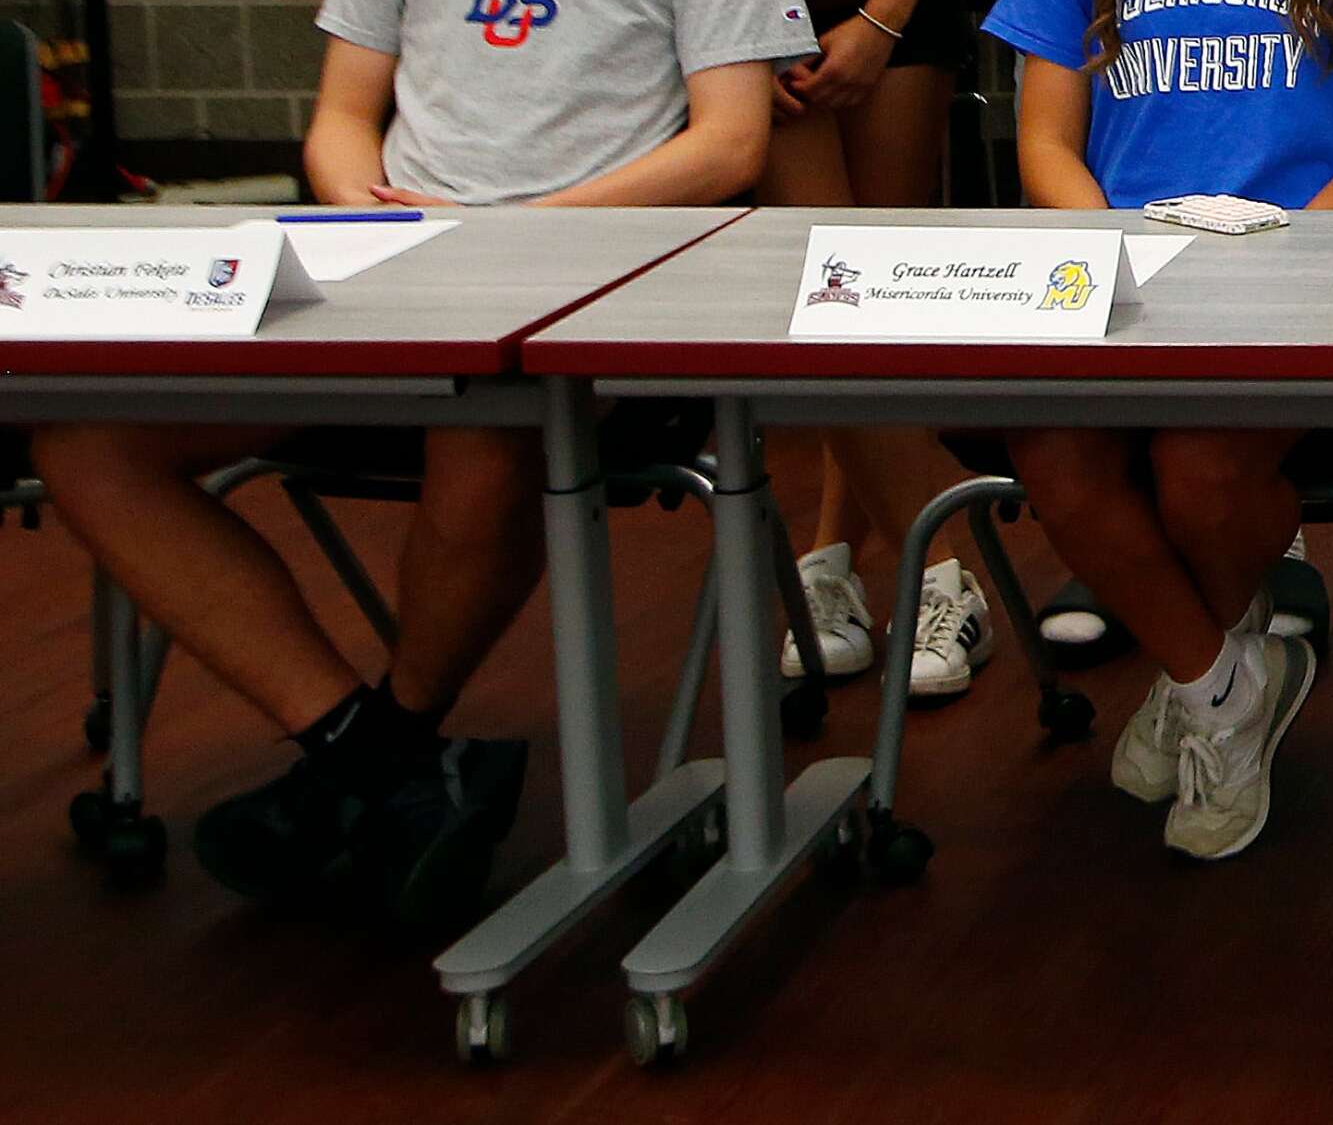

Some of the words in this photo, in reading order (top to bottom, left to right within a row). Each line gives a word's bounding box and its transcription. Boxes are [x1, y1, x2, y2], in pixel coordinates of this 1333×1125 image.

[1106, 33, 1303, 100] UNIVERSITY
[892, 262, 941, 281] Grace
[945, 262, 1021, 279] Hartzell
[865, 286, 952, 301] Misericordia
[958, 287, 1034, 305] University
[1036, 284, 1097, 310] MU
